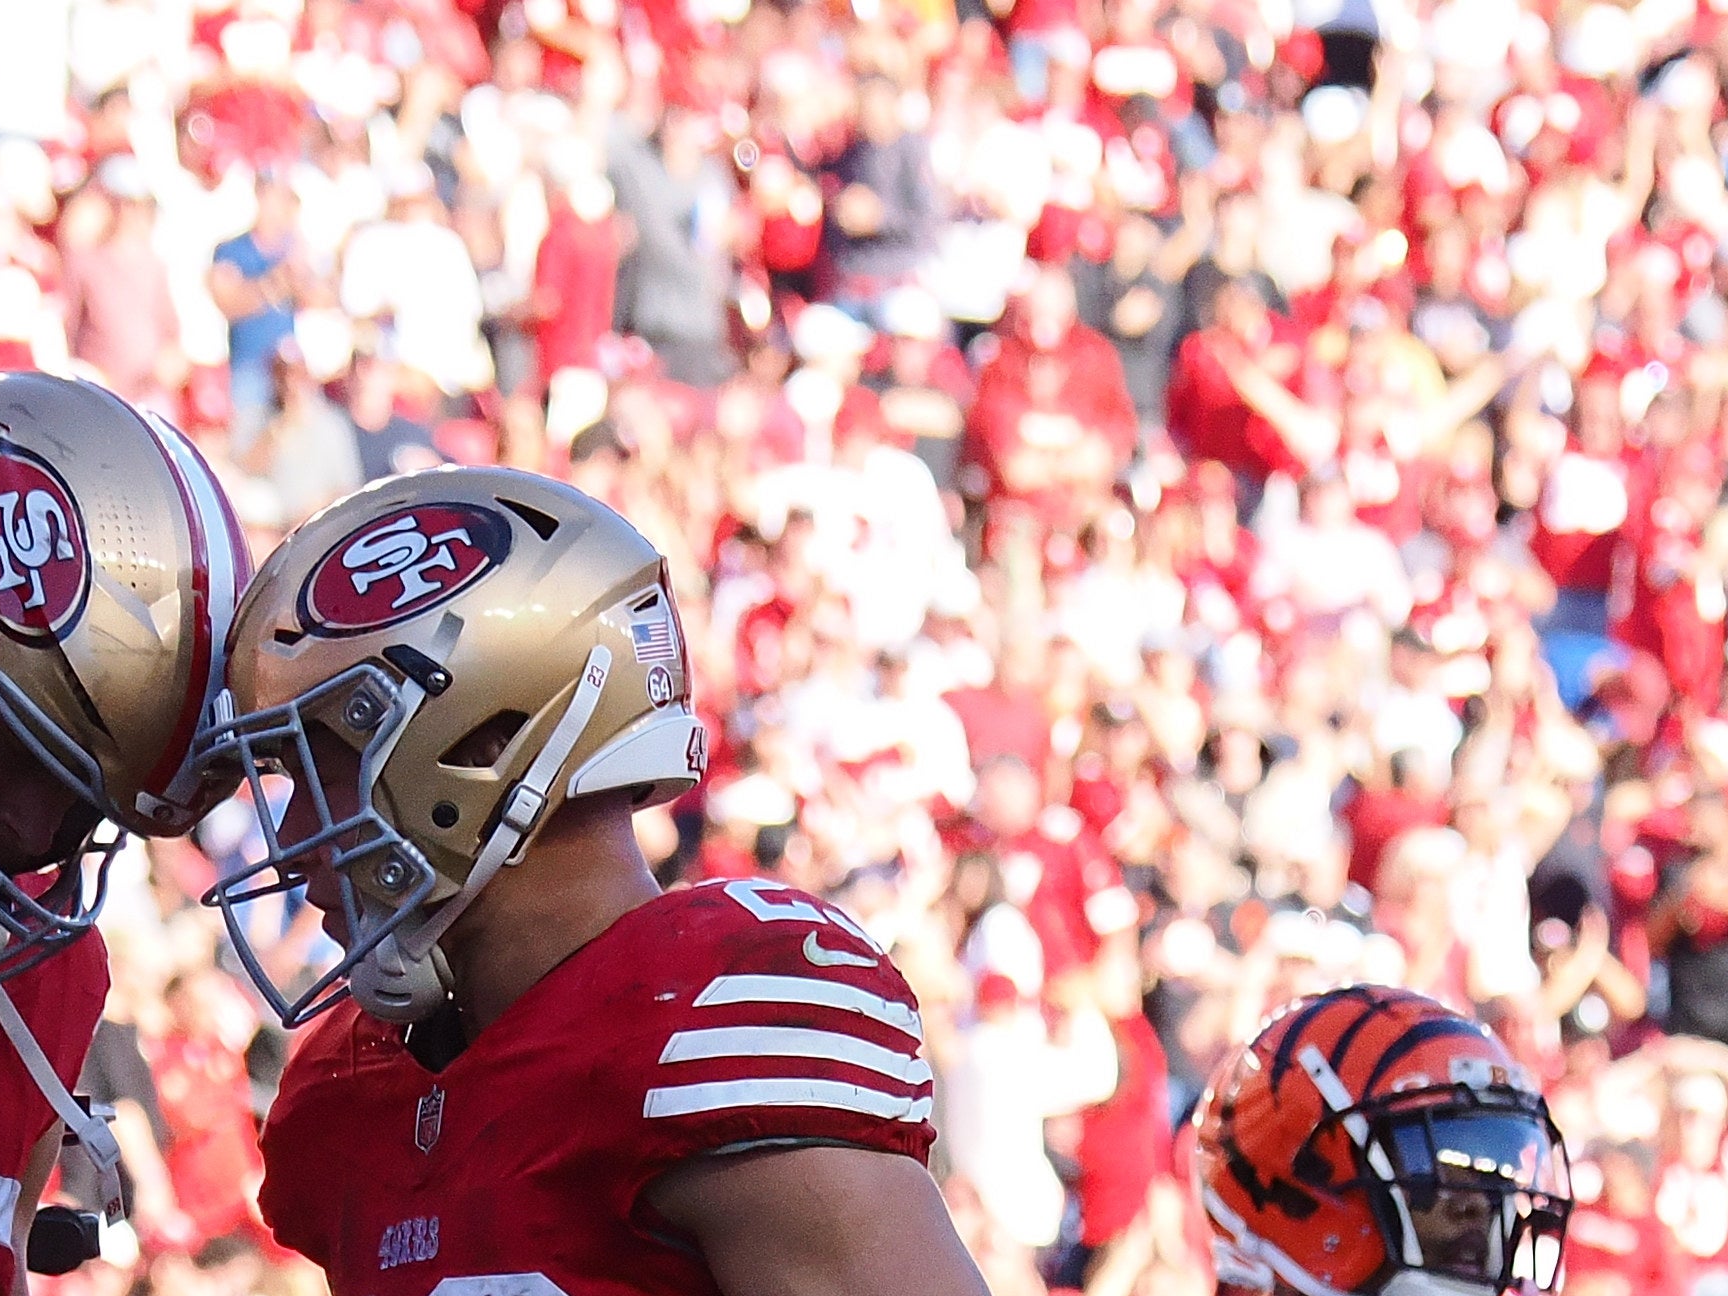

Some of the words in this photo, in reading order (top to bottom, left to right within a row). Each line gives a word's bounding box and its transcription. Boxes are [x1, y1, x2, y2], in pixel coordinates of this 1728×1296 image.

[342, 514, 472, 610] SF
[586, 664, 605, 689] 23
[648, 672, 671, 702] 64
